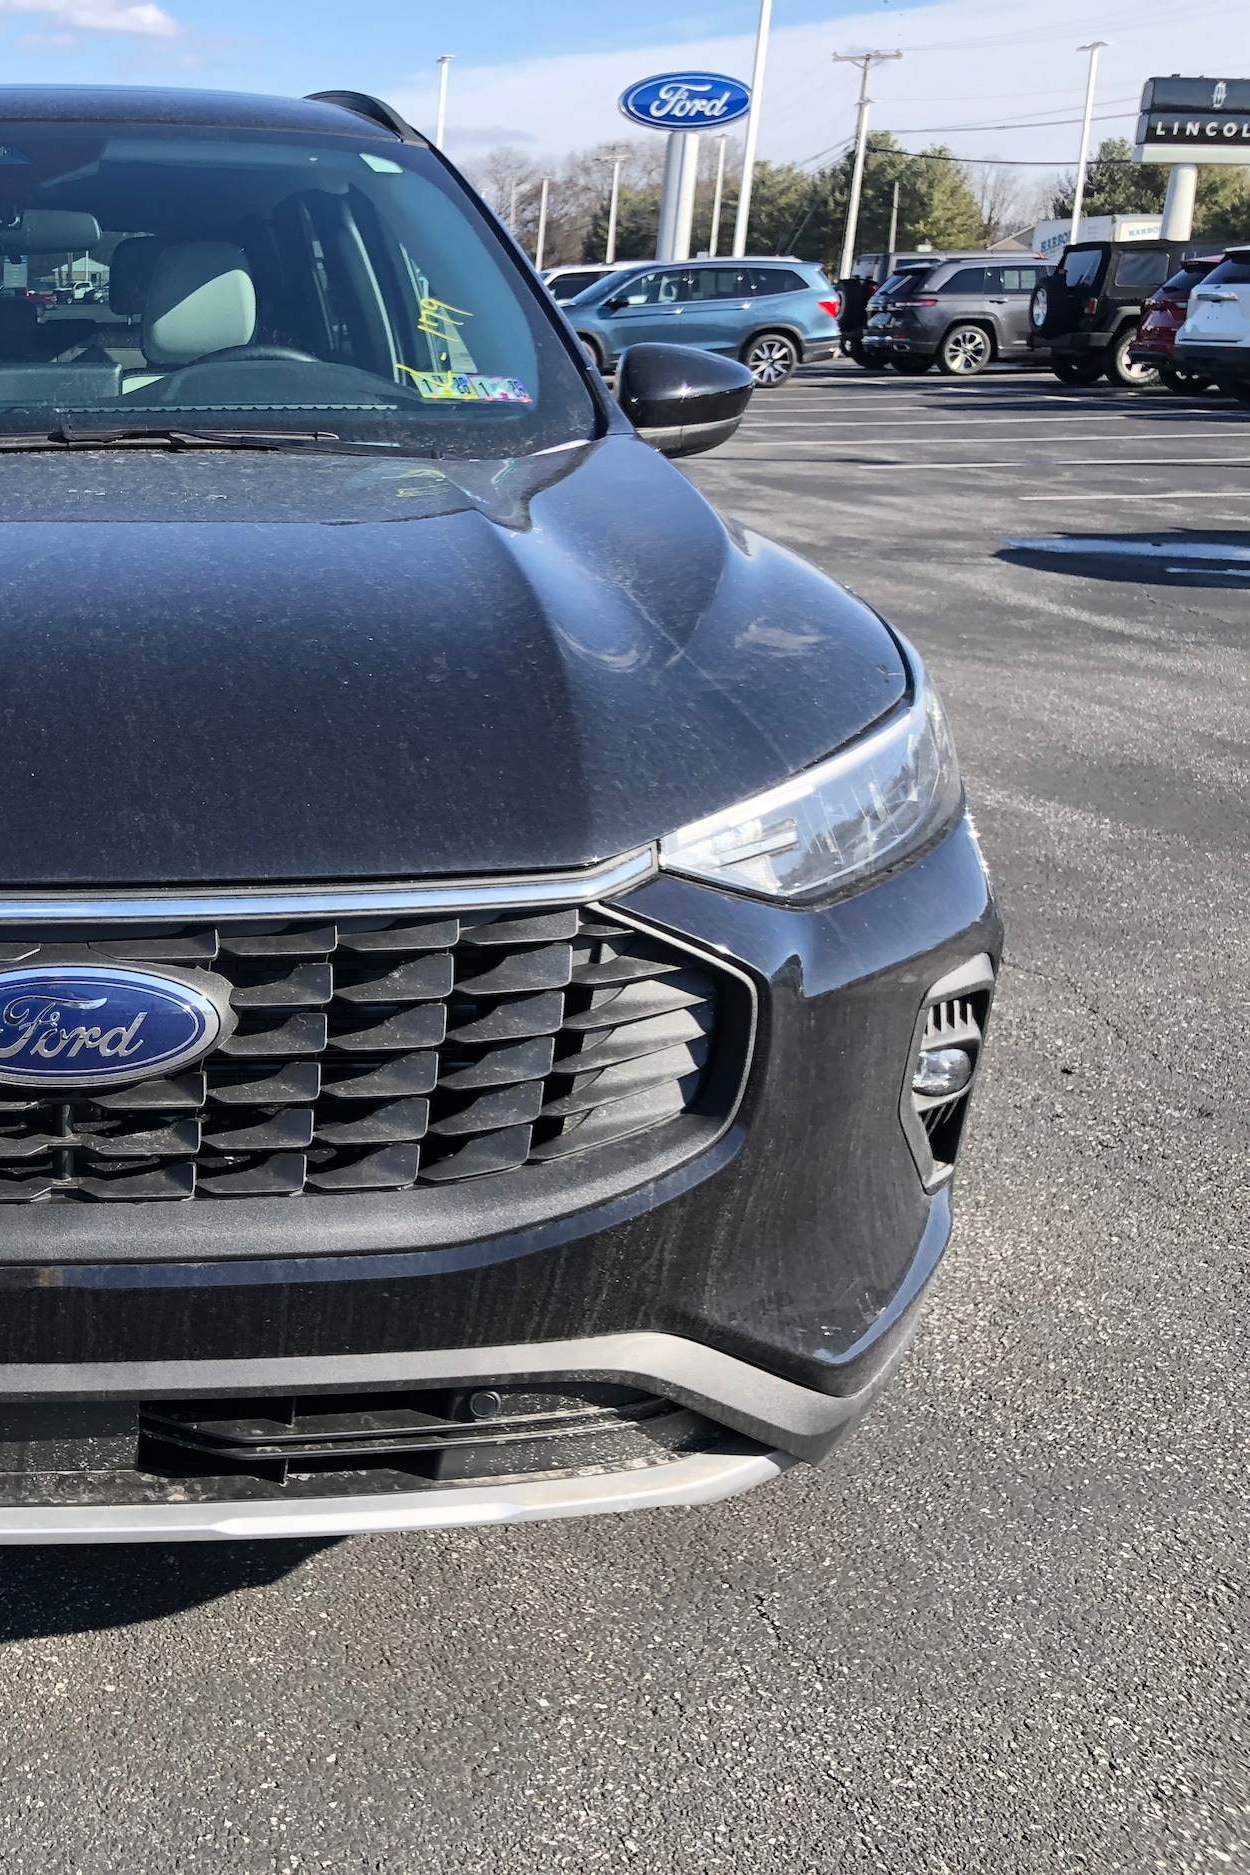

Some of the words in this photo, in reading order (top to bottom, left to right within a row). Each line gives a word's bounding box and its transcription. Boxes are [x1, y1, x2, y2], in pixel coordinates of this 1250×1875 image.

[649, 83, 730, 117] Ford
[1040, 230, 1071, 252] HARBO
[1128, 226, 1161, 237] HARBO
